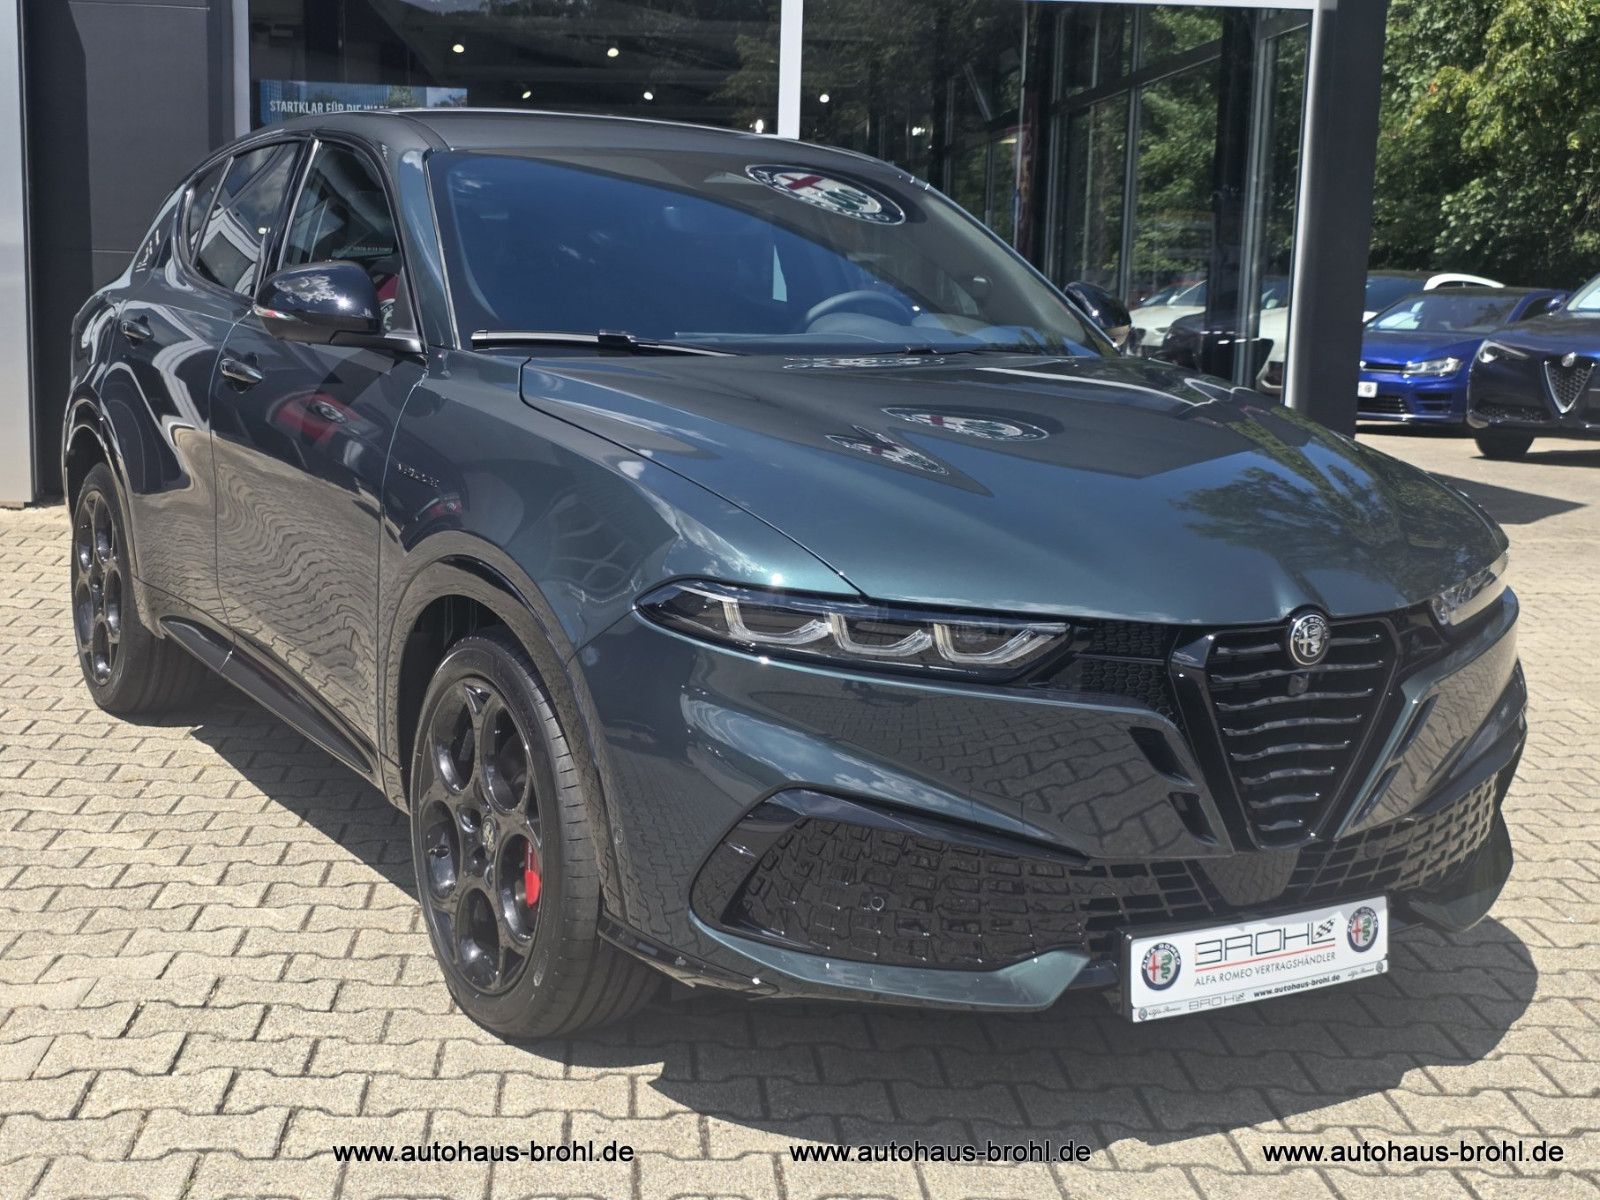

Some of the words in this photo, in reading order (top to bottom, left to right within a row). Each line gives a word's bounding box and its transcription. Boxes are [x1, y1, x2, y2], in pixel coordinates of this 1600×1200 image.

[269, 101, 324, 113] STARTKLAR
[1194, 973, 1217, 986] ALFA
[1219, 967, 1253, 982] ROMEO
[1254, 951, 1337, 976] VERTRAGSHÄNDLER
[1253, 974, 1341, 998] www.autohaus-brohl.de
